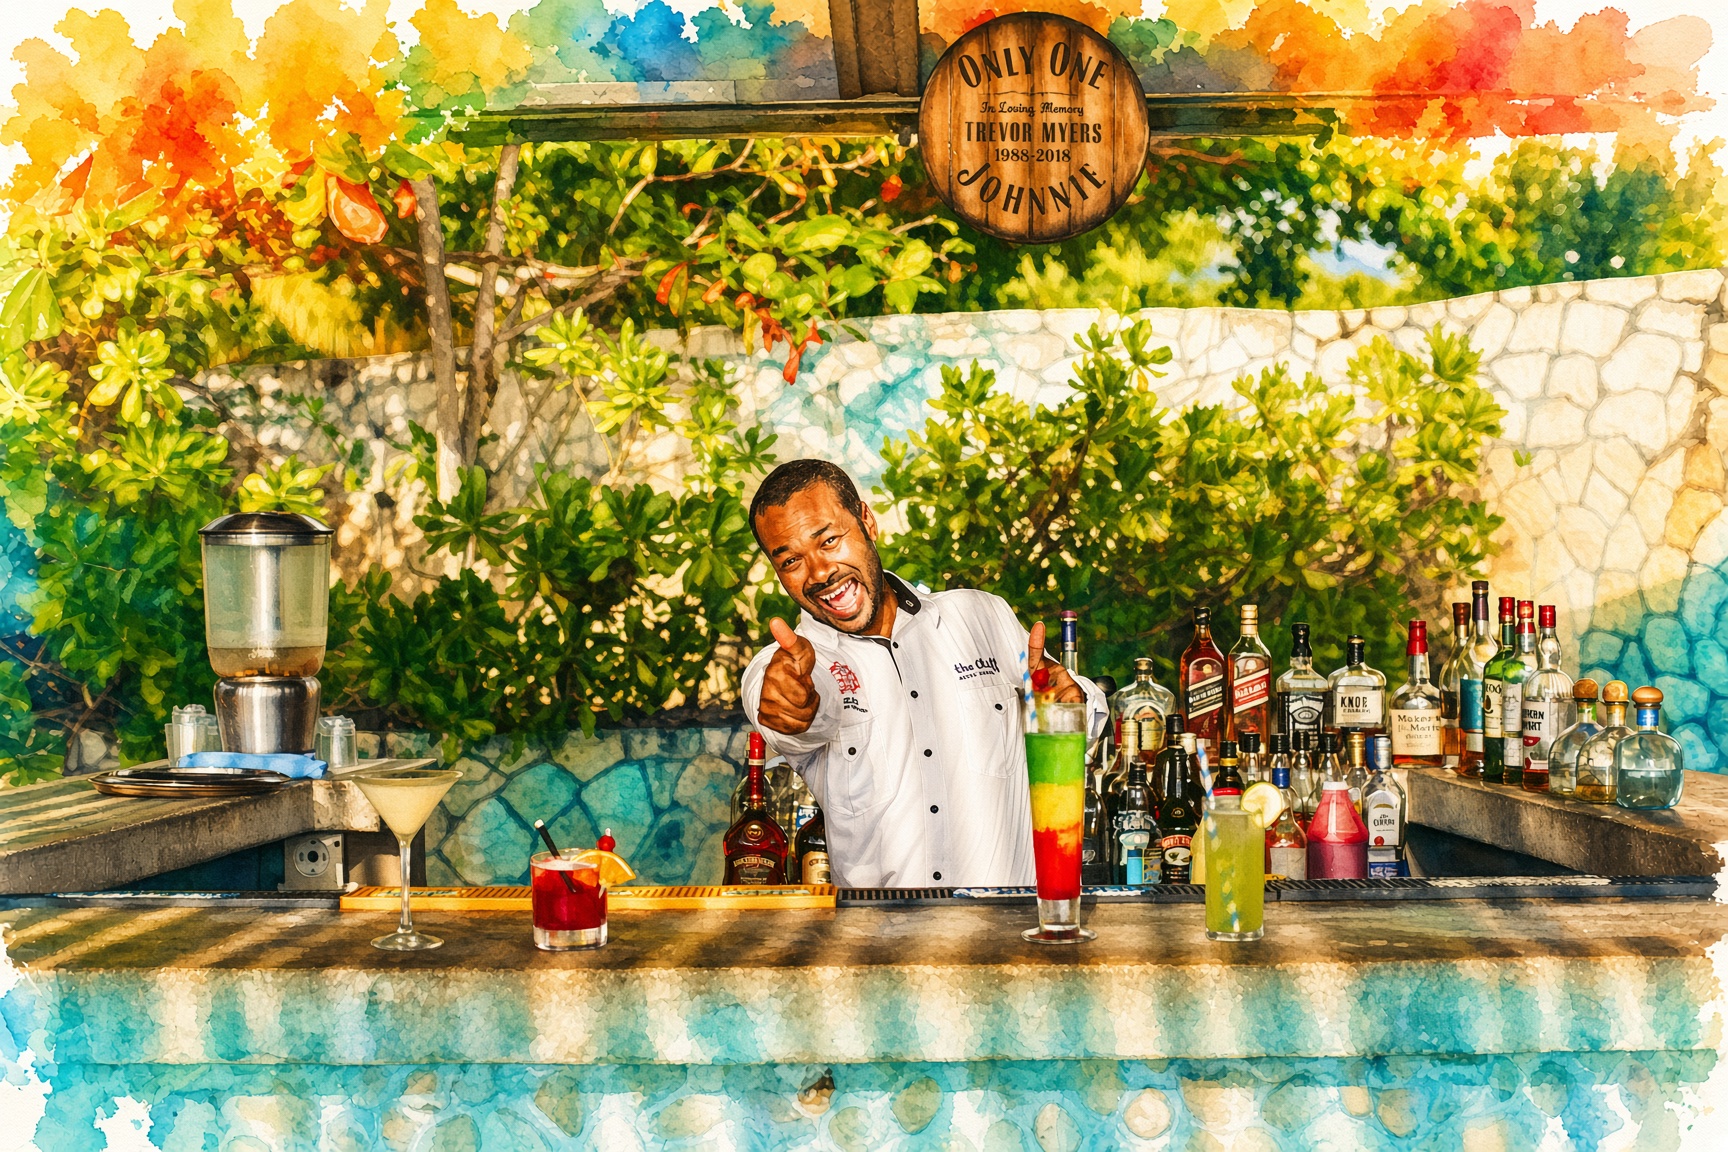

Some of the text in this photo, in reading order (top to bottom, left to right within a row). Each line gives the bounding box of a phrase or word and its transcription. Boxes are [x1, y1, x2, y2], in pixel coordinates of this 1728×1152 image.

[957, 42, 1109, 90] ONLY ONE
[980, 102, 996, 113] In
[1040, 102, 1084, 116] Memory
[965, 121, 1102, 143] TREVOR MYERS
[995, 148, 1072, 162] 1988-2018
[957, 162, 1106, 216] JOHNNIE
